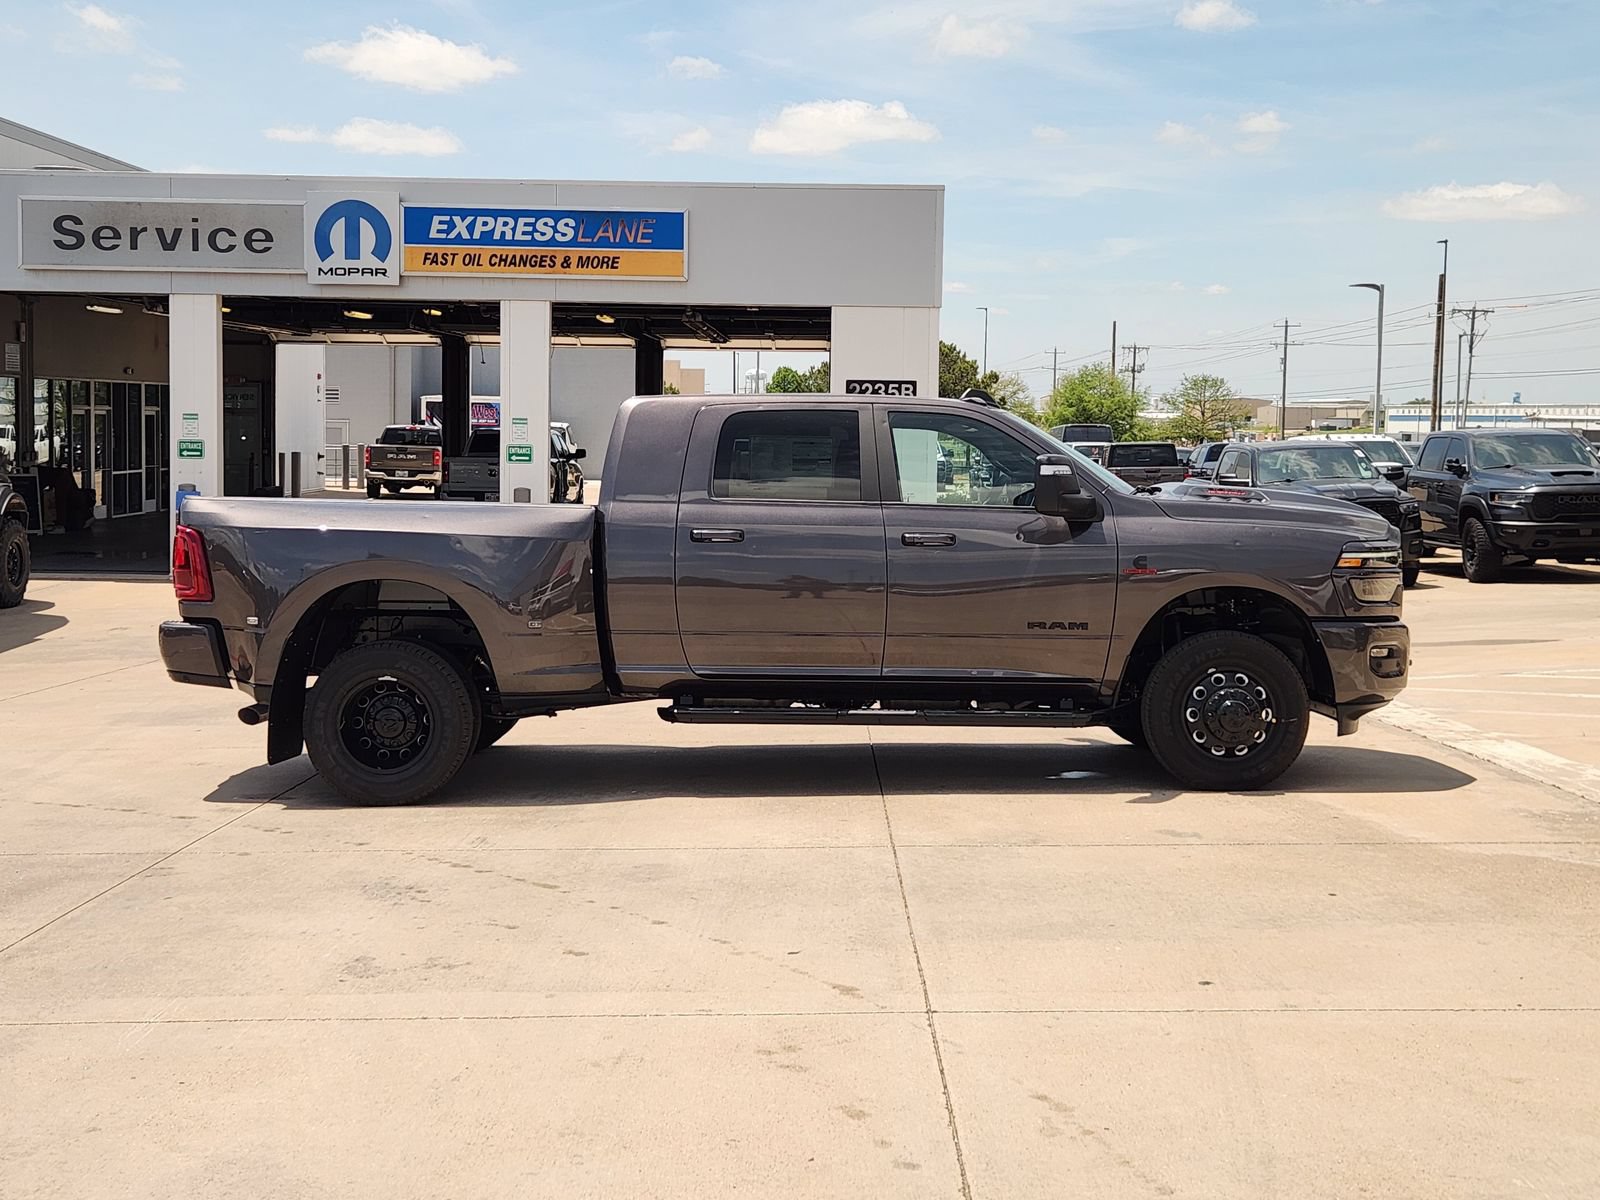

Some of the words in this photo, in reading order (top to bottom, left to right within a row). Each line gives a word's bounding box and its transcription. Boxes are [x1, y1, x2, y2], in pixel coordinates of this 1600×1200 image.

[52, 214, 275, 254] Service
[422, 252, 460, 267] FAST
[462, 253, 484, 268] OIL
[488, 253, 557, 269] CHANGES
[560, 256, 572, 269] &
[576, 255, 620, 270] MORE
[317, 267, 388, 277] MOPAR
[180, 442, 202, 450] ENTRANCE
[509, 447, 531, 455] ENTRANCE
[1027, 621, 1089, 631] RAM
